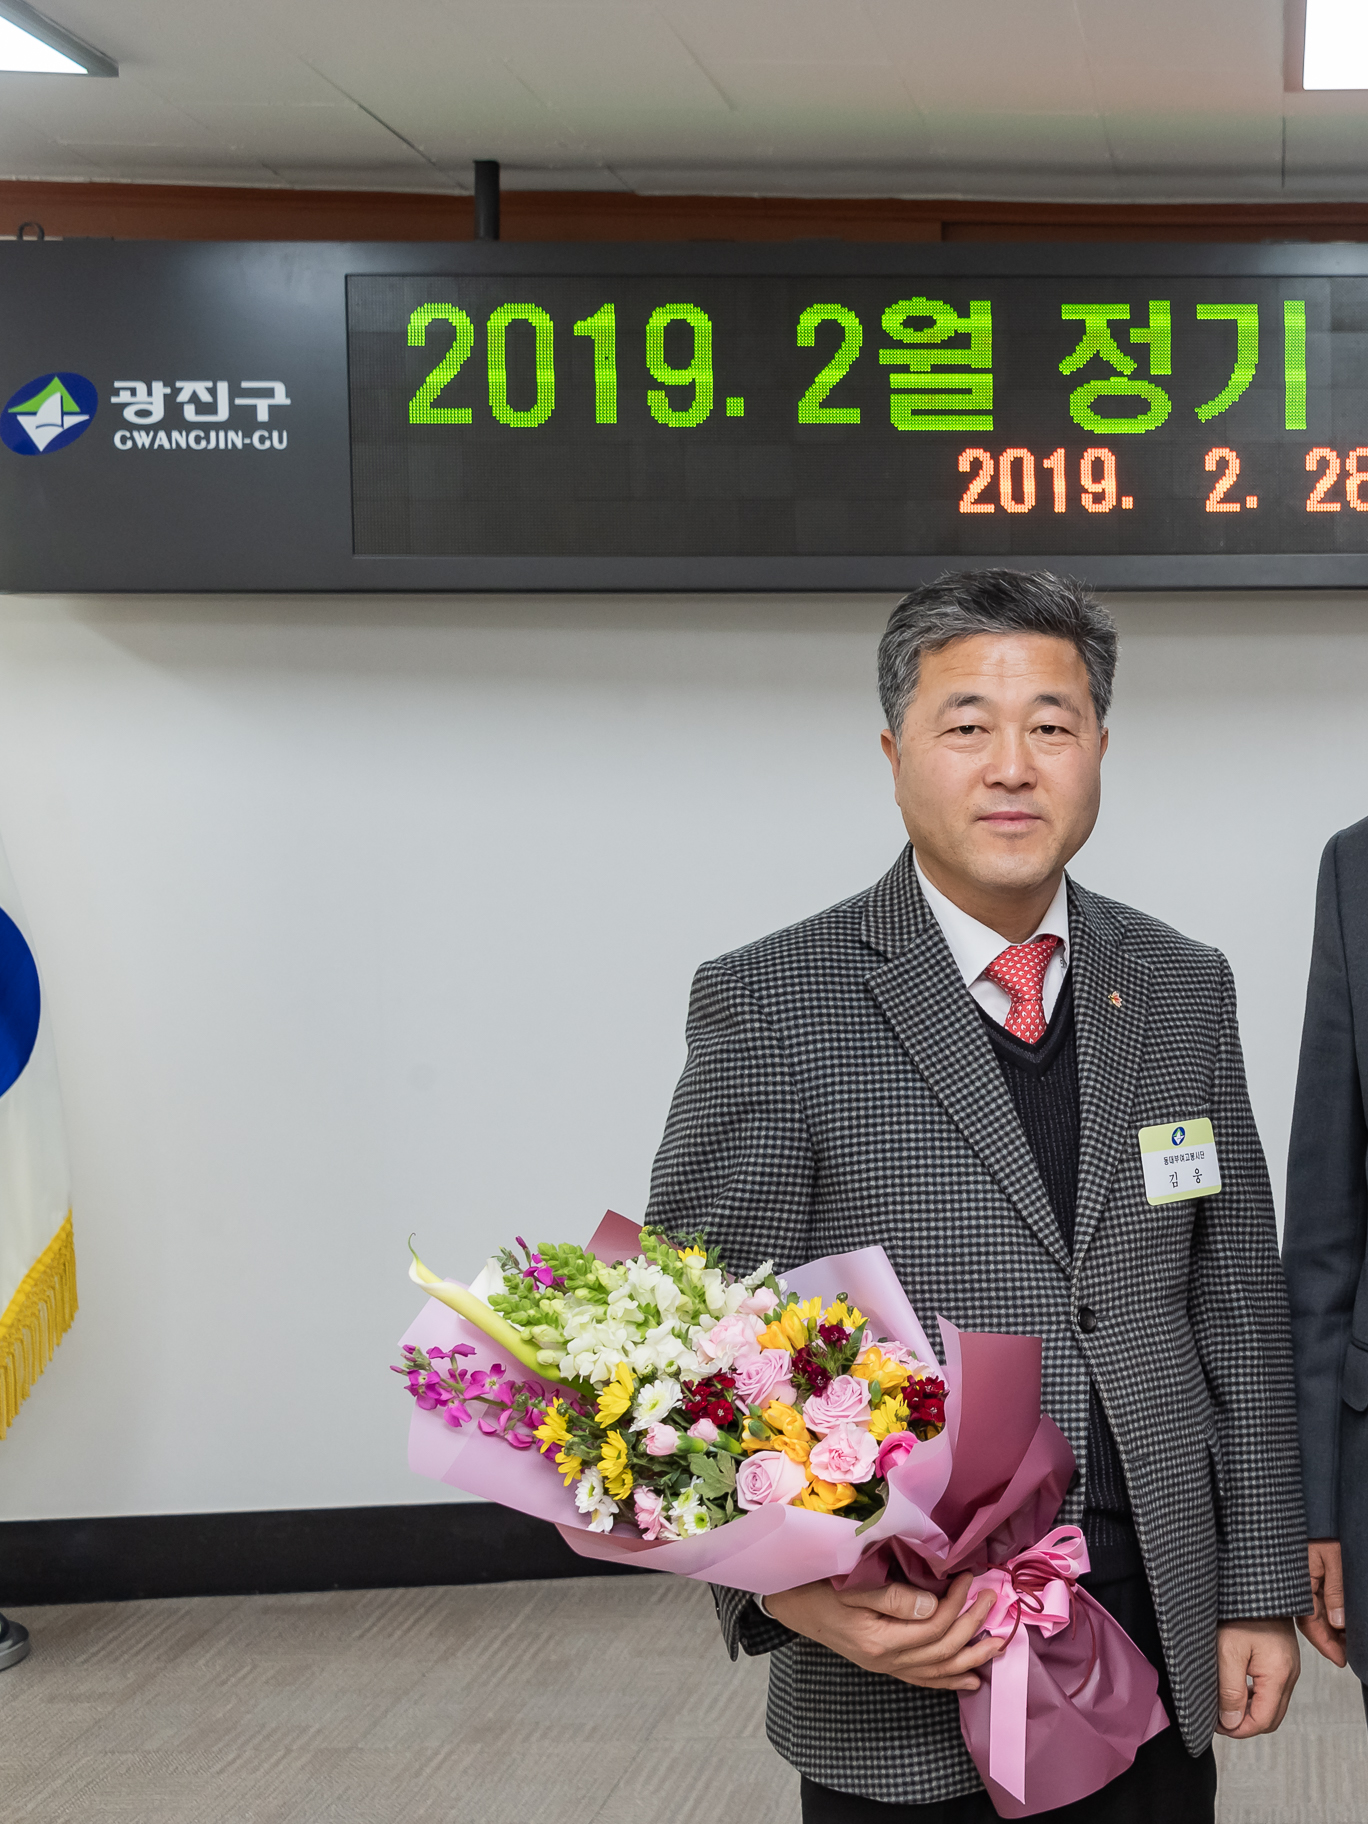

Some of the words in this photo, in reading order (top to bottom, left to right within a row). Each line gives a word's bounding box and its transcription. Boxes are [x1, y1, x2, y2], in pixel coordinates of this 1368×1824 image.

[406, 302, 745, 428] 2019.
[796, 296, 994, 432] 2월
[1058, 299, 1307, 434] 정기
[110, 380, 292, 425] 광진구
[113, 429, 288, 450] GWANGJIN-GU
[957, 447, 1134, 514] 2019.
[1204, 446, 1259, 513] 2.
[1169, 1171, 1179, 1188] 김
[1192, 1168, 1202, 1183] 웅
